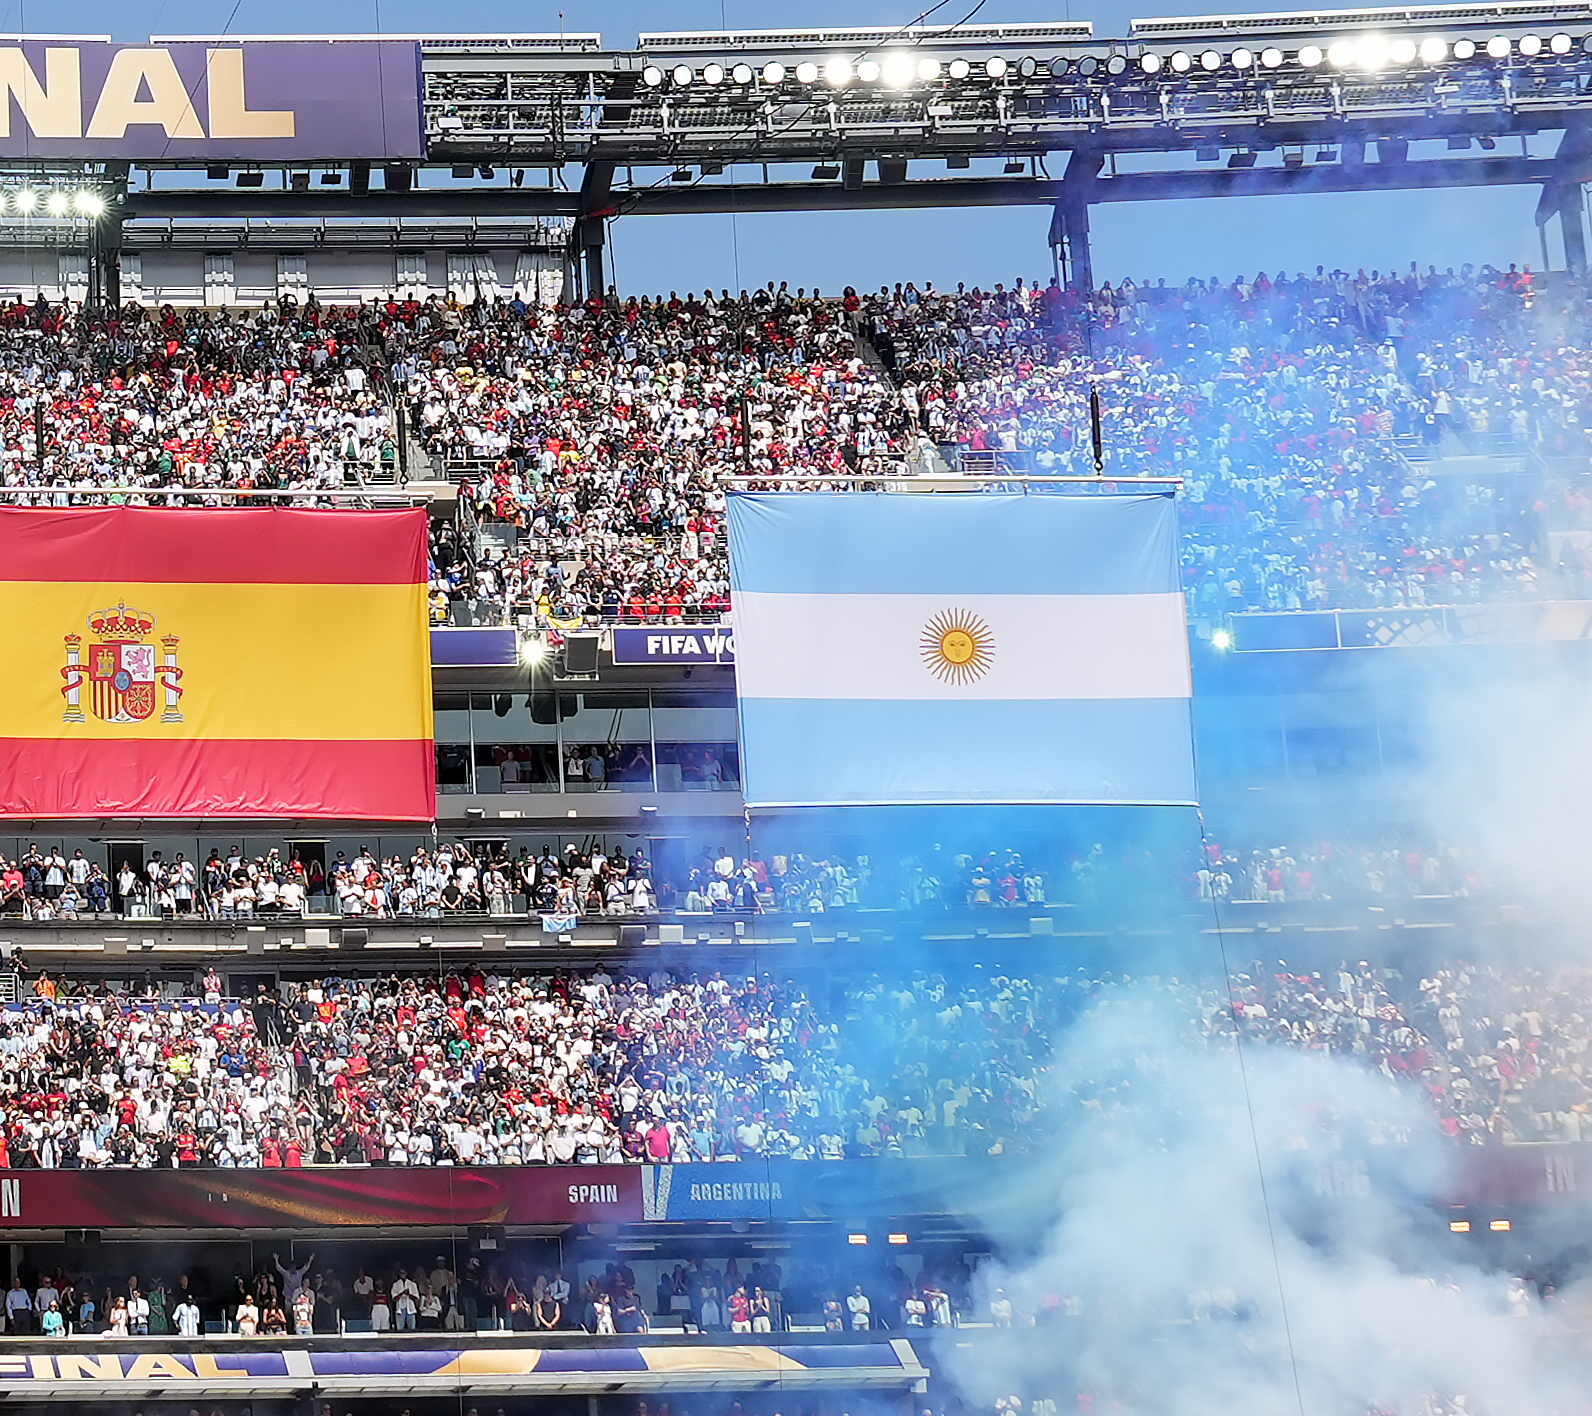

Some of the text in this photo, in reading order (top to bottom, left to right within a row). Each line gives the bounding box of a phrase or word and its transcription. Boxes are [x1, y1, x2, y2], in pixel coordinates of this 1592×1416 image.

[647, 634, 703, 655] FIFA
[568, 1183, 619, 1205] SPAIN
[689, 1181, 783, 1203] ARGENTINA
